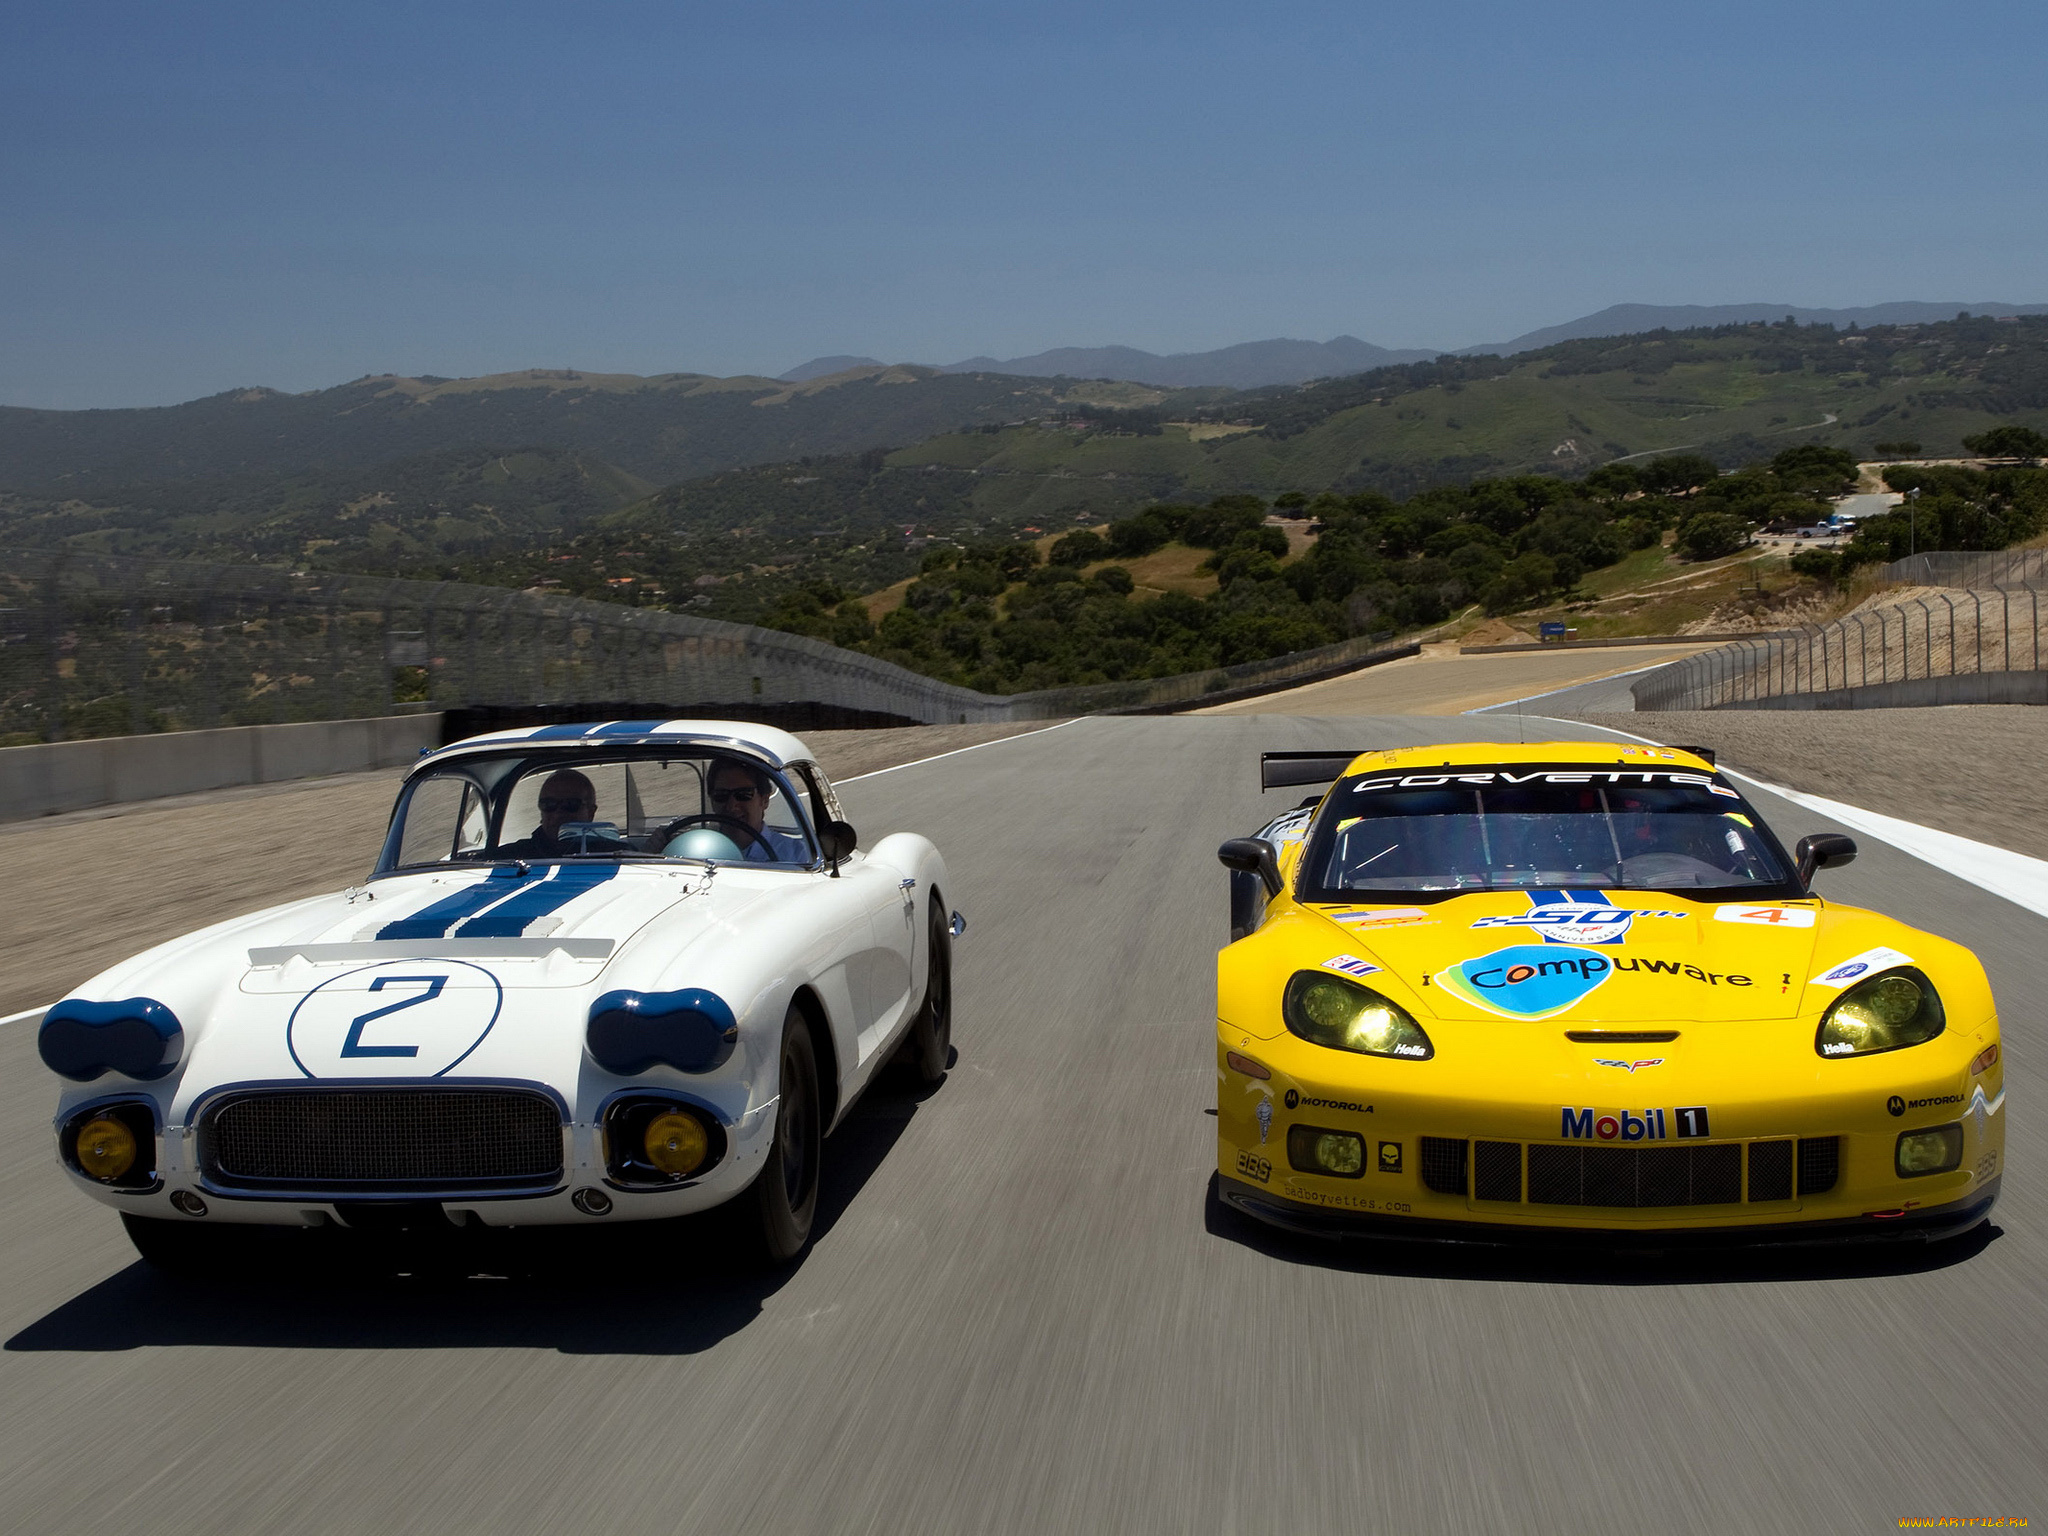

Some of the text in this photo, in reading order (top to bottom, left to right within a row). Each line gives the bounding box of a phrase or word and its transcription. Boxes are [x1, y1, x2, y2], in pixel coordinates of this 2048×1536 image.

[1353, 771, 1712, 793] CORVETTE
[1740, 909, 1788, 923] 4
[1543, 928, 1619, 941] ANNIVERSARY
[1470, 957, 1753, 988] Compuware
[340, 976, 449, 1058] 2
[1394, 1043, 1426, 1056] Hella
[1823, 1042, 1855, 1055] Hella
[1301, 1097, 1374, 1113] MOTOROLA
[1561, 1107, 1698, 1141] Mobil 1
[1236, 1149, 1272, 1184] BBS
[1284, 1183, 1412, 1213] badboyvettes.com
